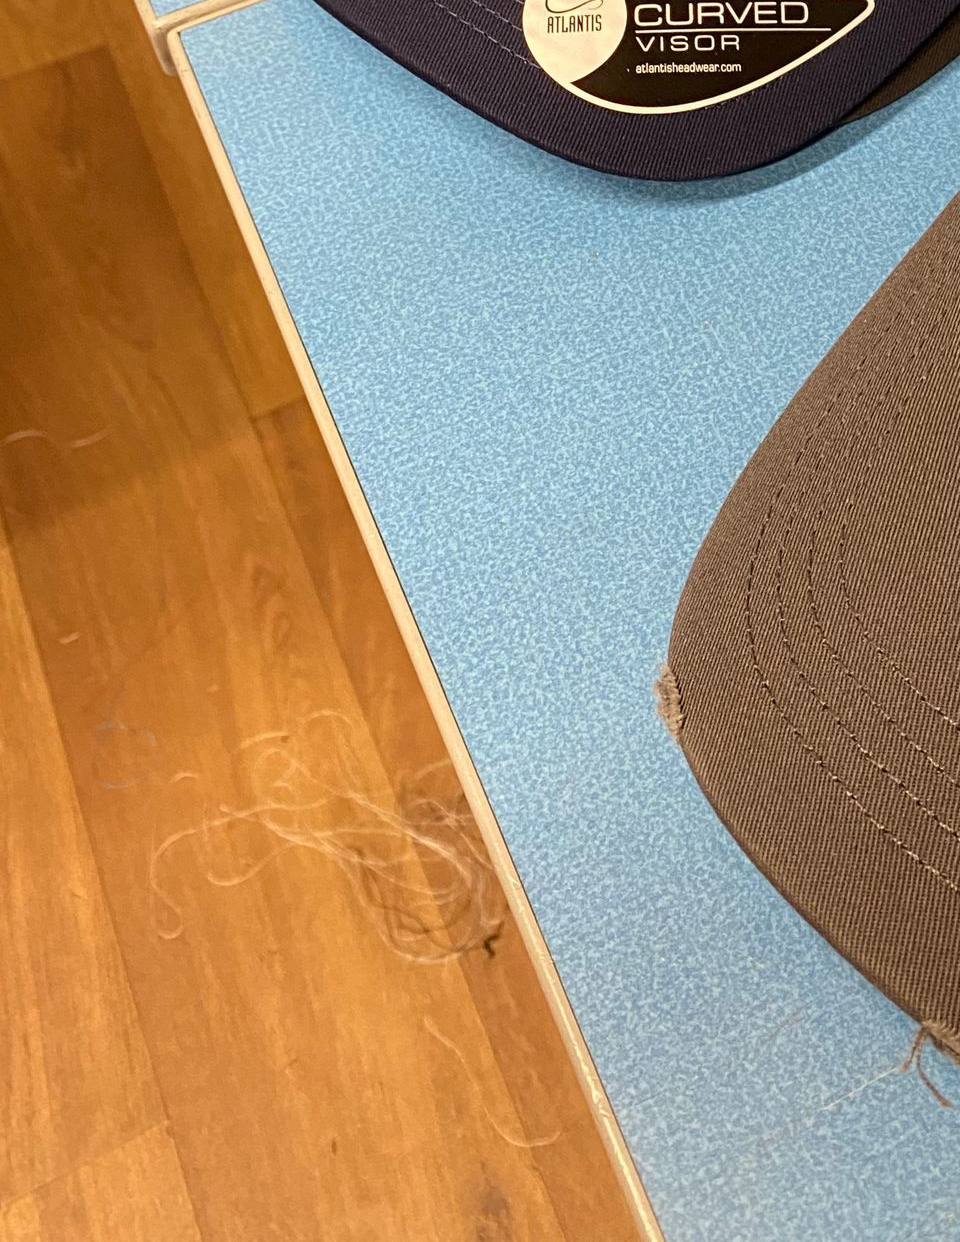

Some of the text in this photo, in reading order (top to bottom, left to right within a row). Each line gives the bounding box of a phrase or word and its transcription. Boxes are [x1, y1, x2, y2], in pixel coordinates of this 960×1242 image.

[547, 14, 603, 34] ATLANTIS
[633, 1, 809, 28] CURVED
[635, 34, 740, 53] VISOR
[635, 61, 742, 74] atlantisheadwear.com
